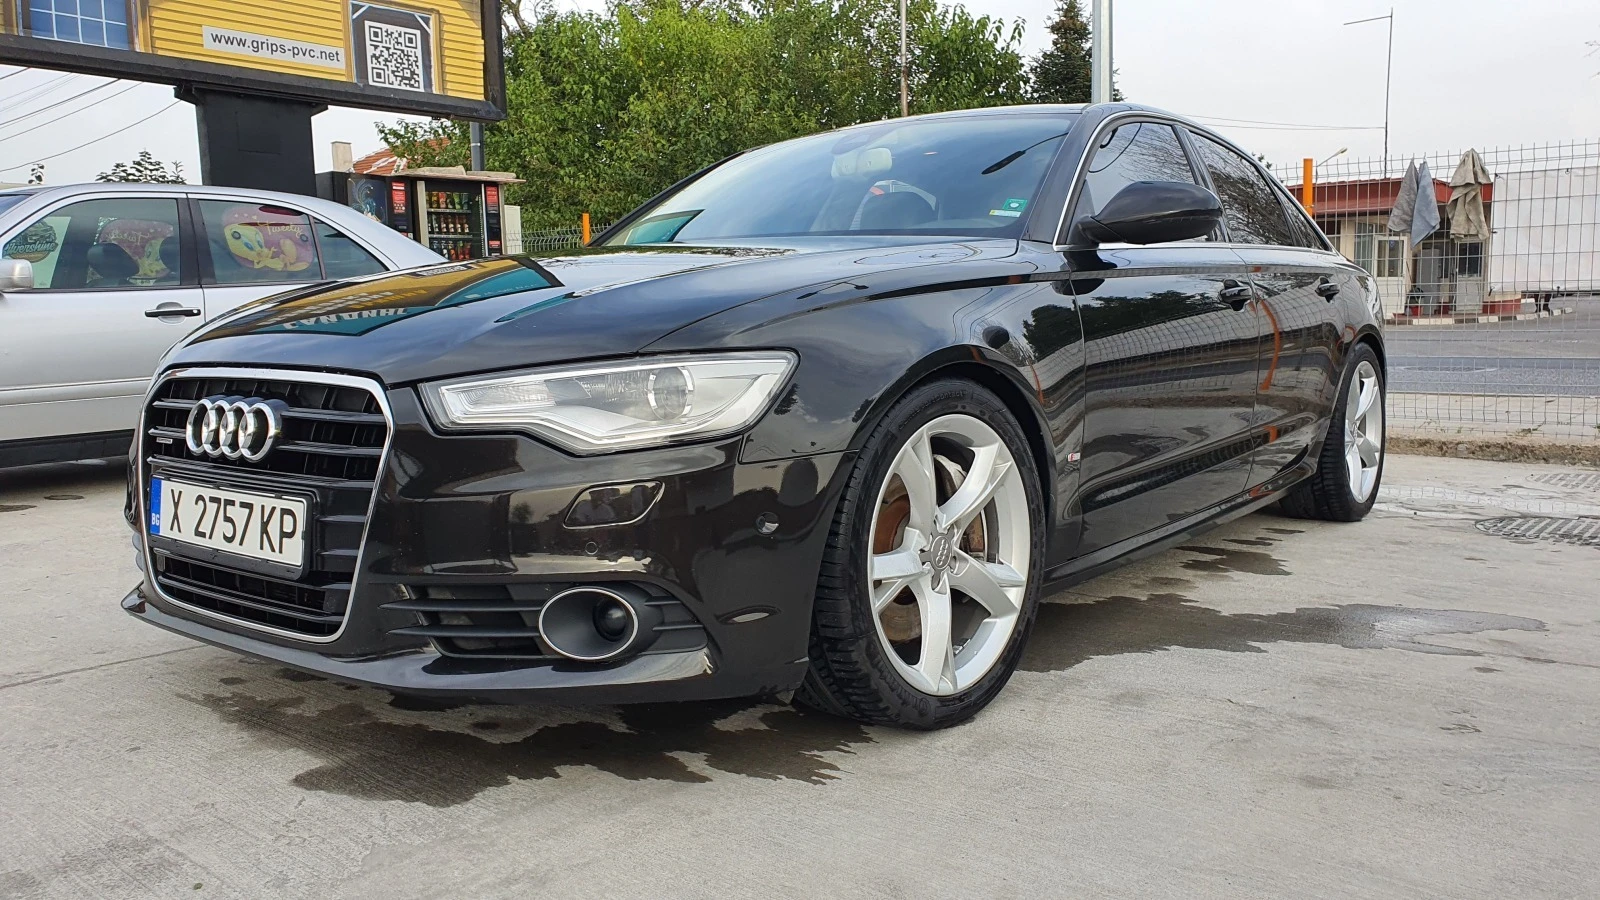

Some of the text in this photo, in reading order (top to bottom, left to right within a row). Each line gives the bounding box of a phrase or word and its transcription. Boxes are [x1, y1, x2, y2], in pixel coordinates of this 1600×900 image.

[210, 32, 340, 62] www.grips-pvc.net
[257, 220, 303, 239] Tweety
[151, 511, 160, 527] BG
[169, 488, 298, 555] X 2757 KP
